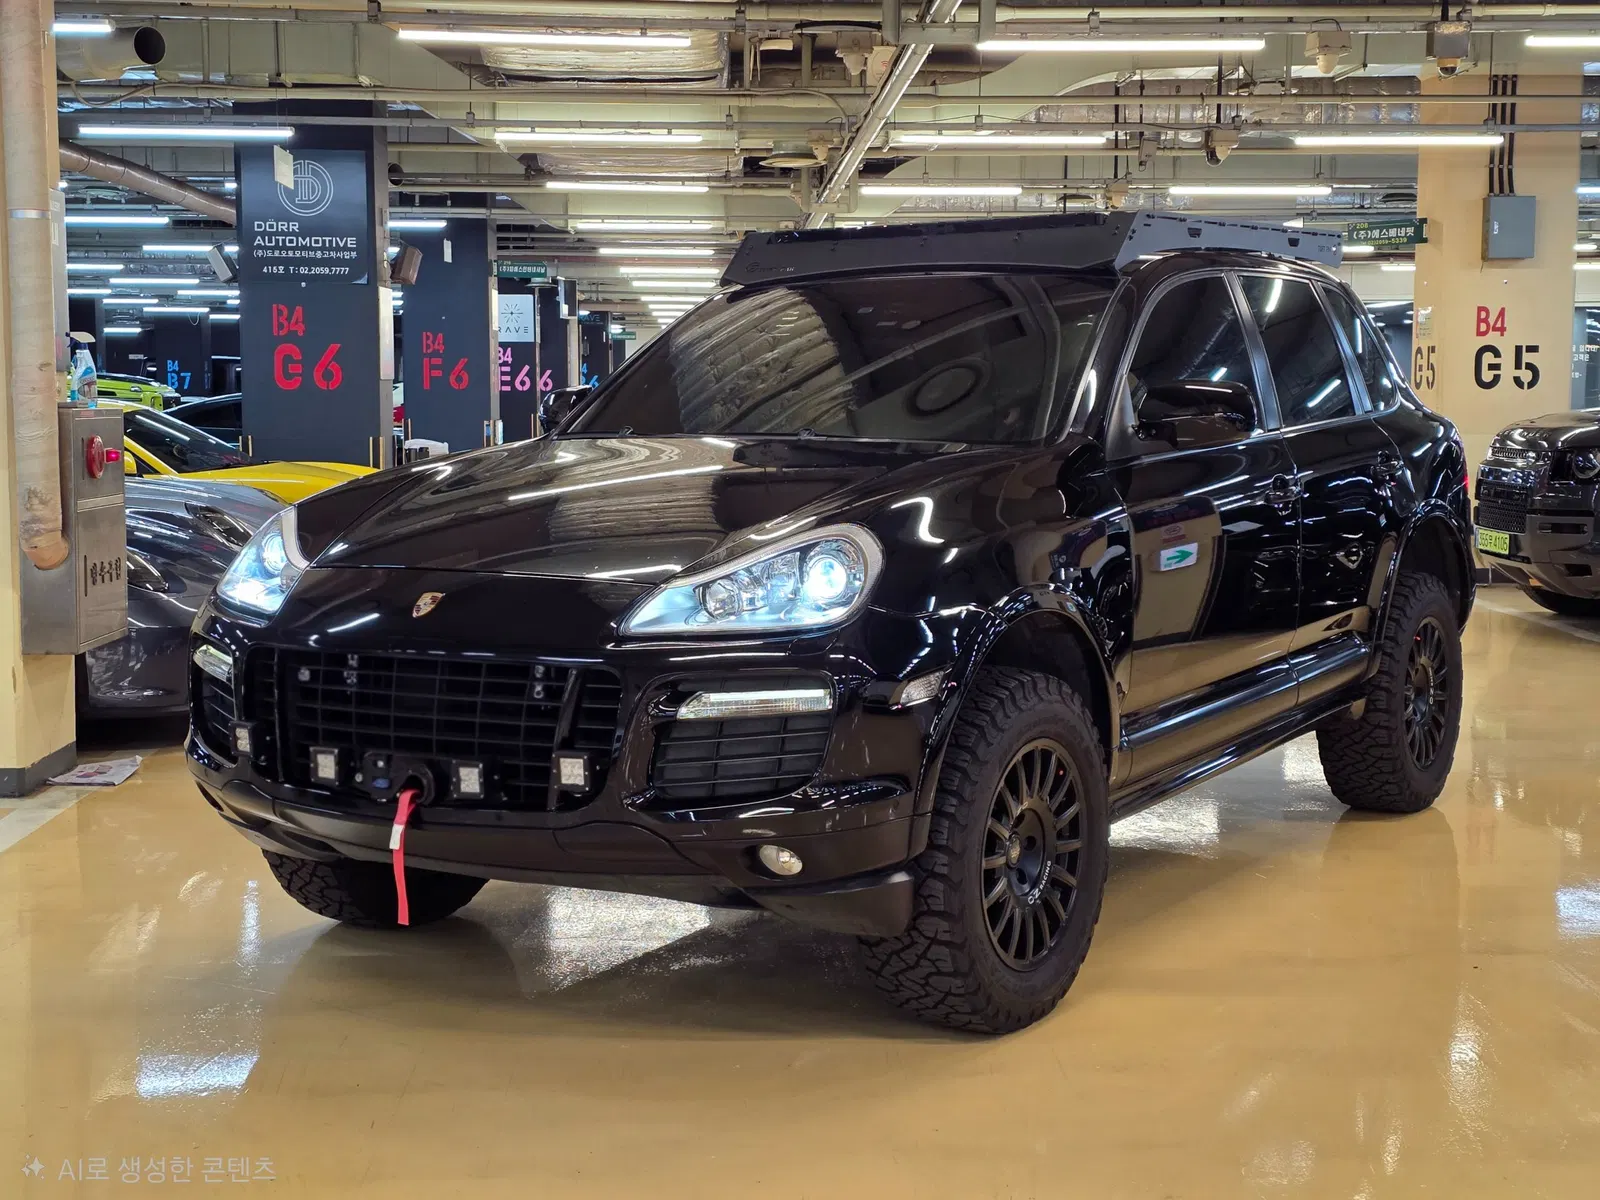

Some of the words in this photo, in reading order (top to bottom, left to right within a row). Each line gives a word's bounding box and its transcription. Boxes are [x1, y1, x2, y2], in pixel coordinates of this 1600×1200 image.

[254, 219, 299, 232] DÖRR
[254, 236, 357, 248] AUTOMOTIVE
[272, 303, 306, 336] B4
[1475, 305, 1507, 337] B4
[422, 331, 445, 354] B4
[166, 359, 180, 371] B4
[1039, 860, 1051, 889] RACING
